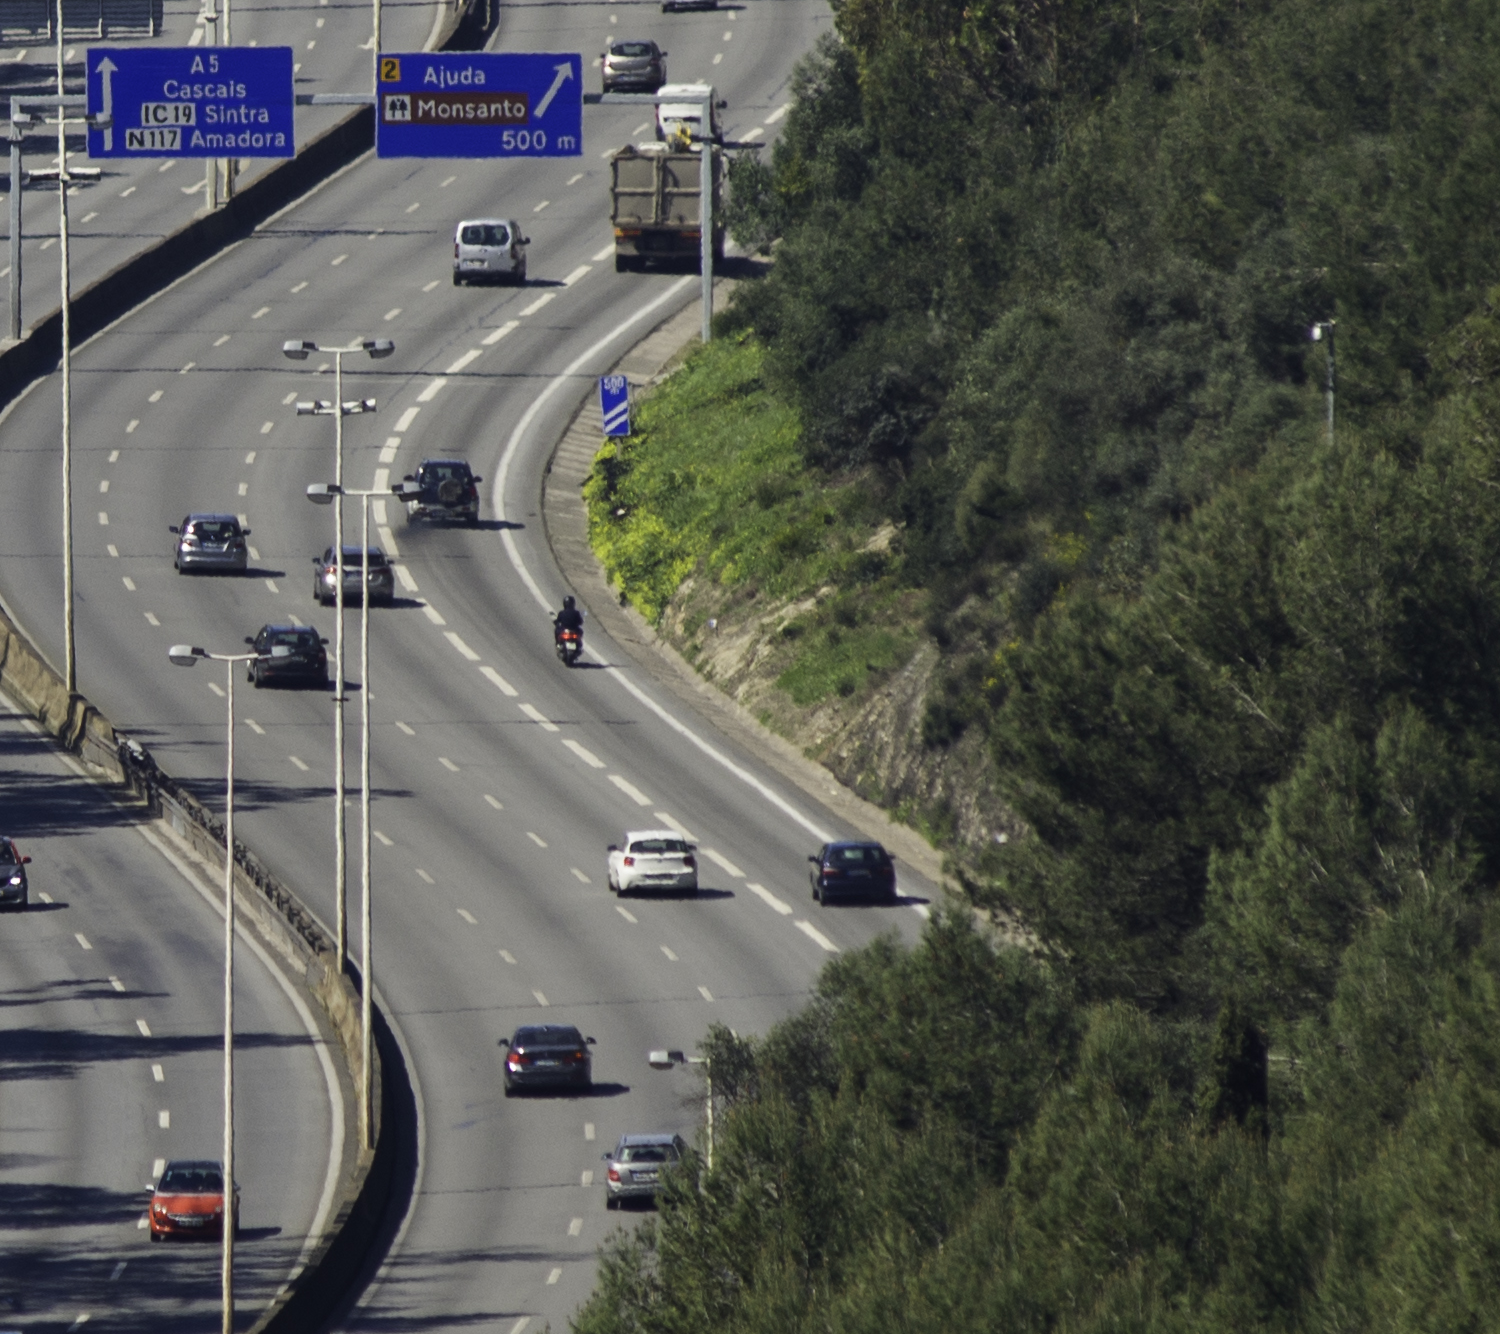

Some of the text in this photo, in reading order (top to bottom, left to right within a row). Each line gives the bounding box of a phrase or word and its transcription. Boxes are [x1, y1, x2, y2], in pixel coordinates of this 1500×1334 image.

[384, 60, 397, 80] 2
[423, 66, 485, 89] Ajuda
[163, 80, 246, 99] Cascais
[205, 105, 269, 123] Sintra
[417, 100, 525, 118] Monsanto
[190, 129, 286, 148] Amadora
[502, 130, 575, 150] 500 m
